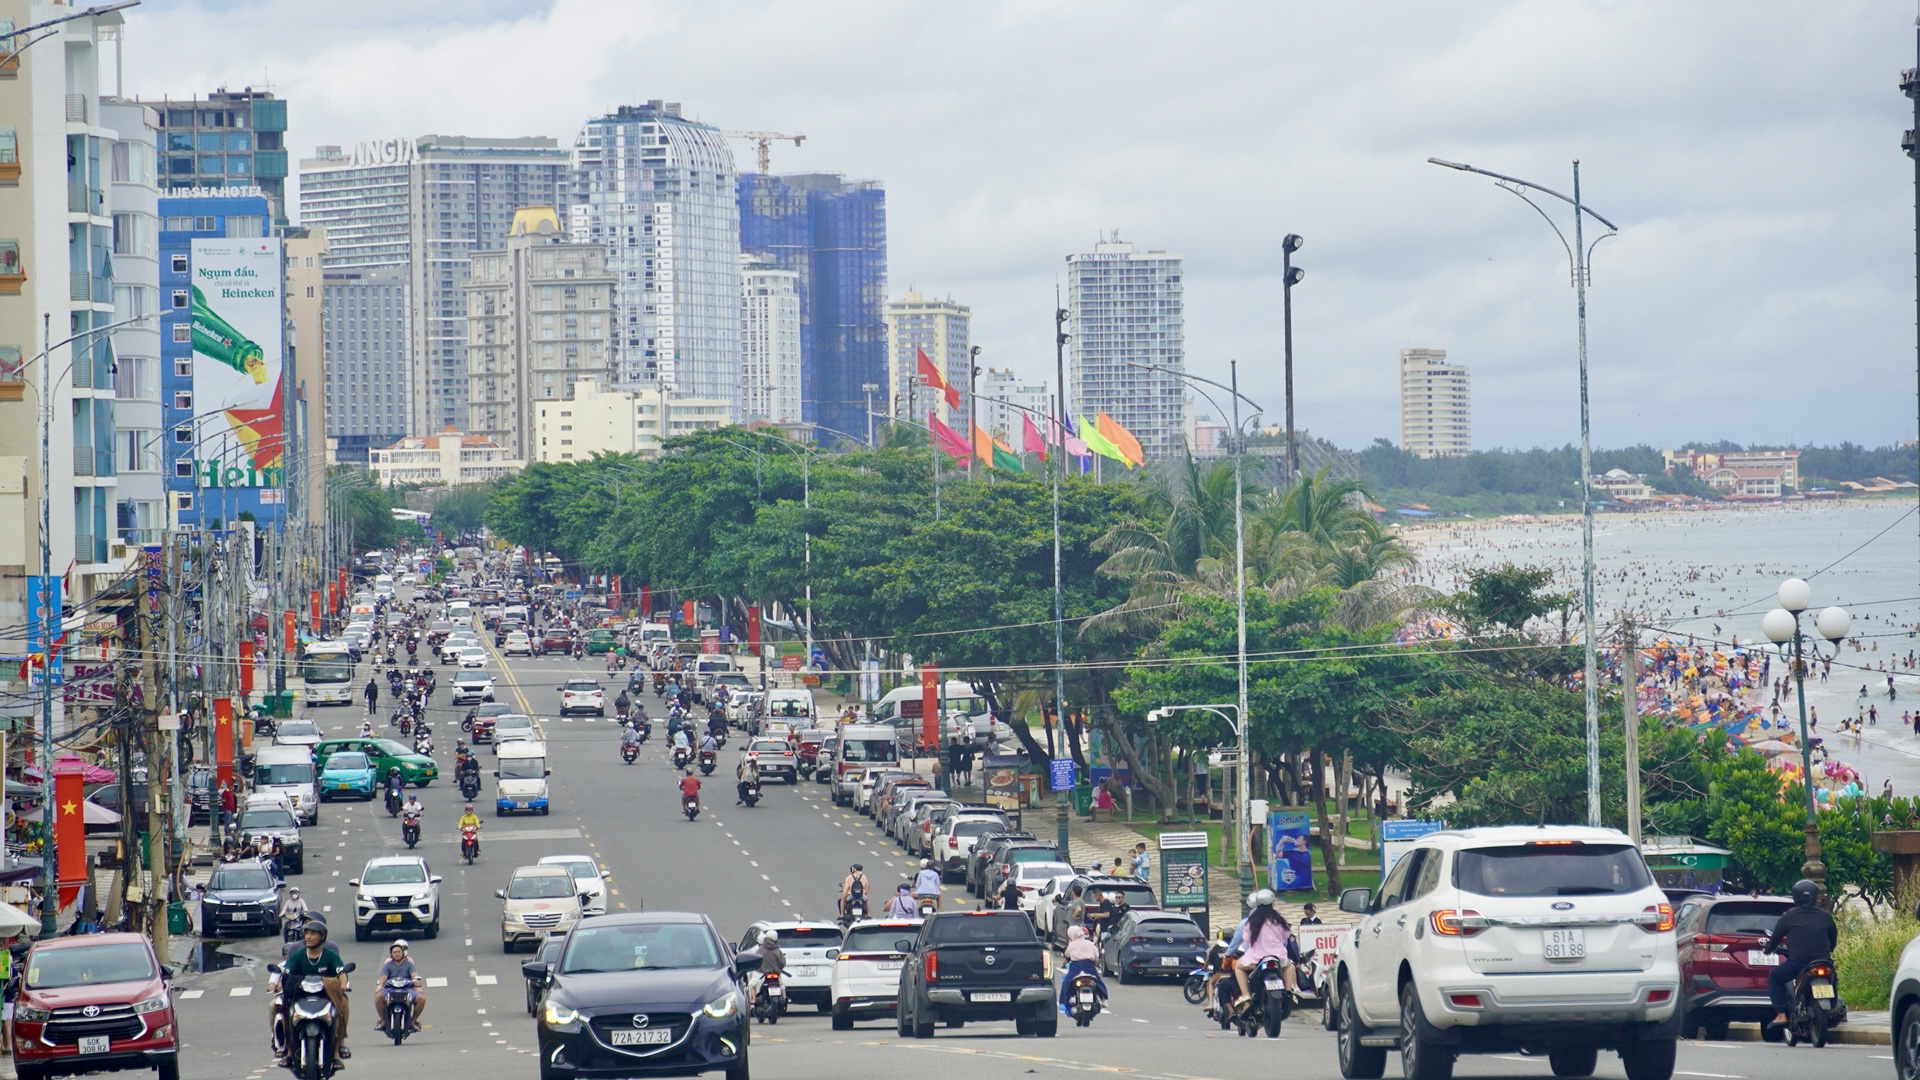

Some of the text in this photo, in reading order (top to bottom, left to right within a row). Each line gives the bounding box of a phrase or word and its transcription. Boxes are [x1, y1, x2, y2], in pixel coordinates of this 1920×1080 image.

[220, 186, 264, 198] HOTEL
[198, 268, 232, 280] Ngụm
[222, 288, 275, 298] Heineken
[192, 321, 223, 343] Heineken
[1280, 815, 1304, 823] Revive
[1555, 902, 1570, 910] Ford
[1315, 934, 1338, 950] GIỮ
[1552, 931, 1574, 944] 61A
[1545, 944, 1584, 957] 681.88
[87, 1038, 100, 1046] 60K
[613, 1031, 669, 1044] 72A-217.32
